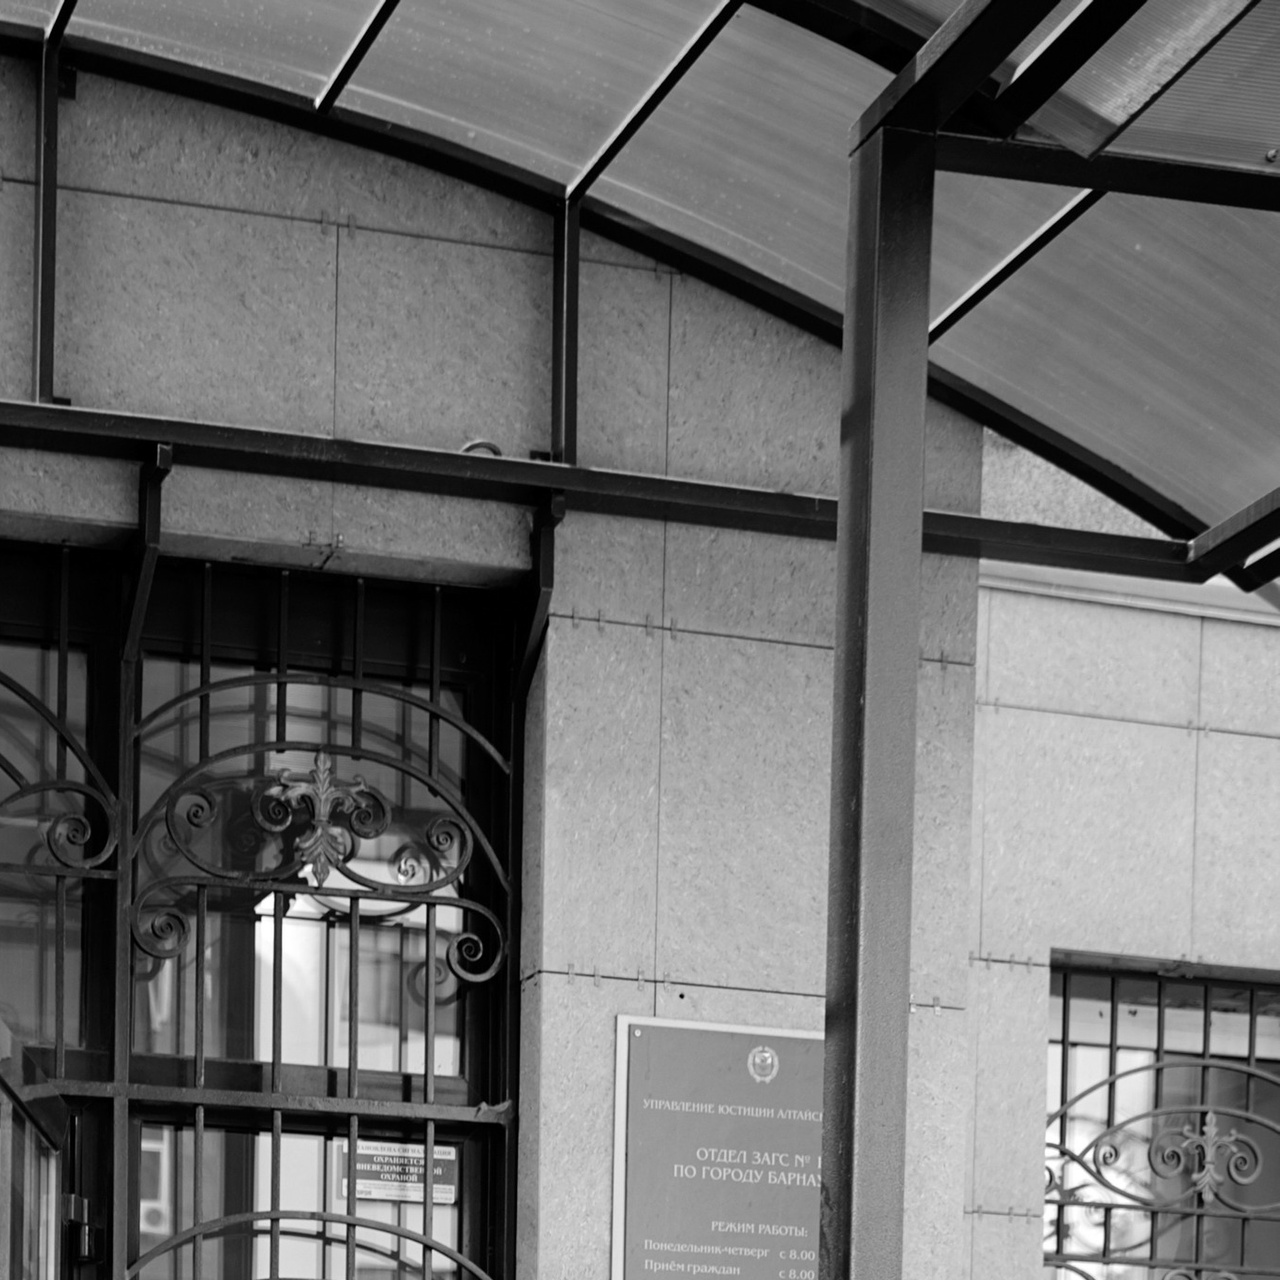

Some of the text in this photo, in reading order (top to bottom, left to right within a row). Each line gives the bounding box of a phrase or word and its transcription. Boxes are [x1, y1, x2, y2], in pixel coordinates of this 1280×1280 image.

[643, 1099, 715, 1114] УПРАВЛЕНИЕ
[718, 1104, 774, 1119] ЮСТИЦИИ
[696, 1147, 747, 1164] ОТДЕЛ
[752, 1151, 790, 1167] ЗАГС
[356, 1163, 443, 1176] ВНЕВЕДОМСТВЕНЙ
[380, 1173, 418, 1182] ОХРАНОЙ
[673, 1164, 697, 1179] ПО
[702, 1166, 764, 1184] ГОРОДУ
[711, 1221, 809, 1238] РЕЖИМ РАБОТЫ:
[644, 1239, 770, 1260] Понедельник-четверг
[789, 1249, 816, 1262] 8.00
[644, 1259, 685, 1273] Приём
[687, 1263, 741, 1276] граждан
[788, 1269, 816, 1280] 8.00
